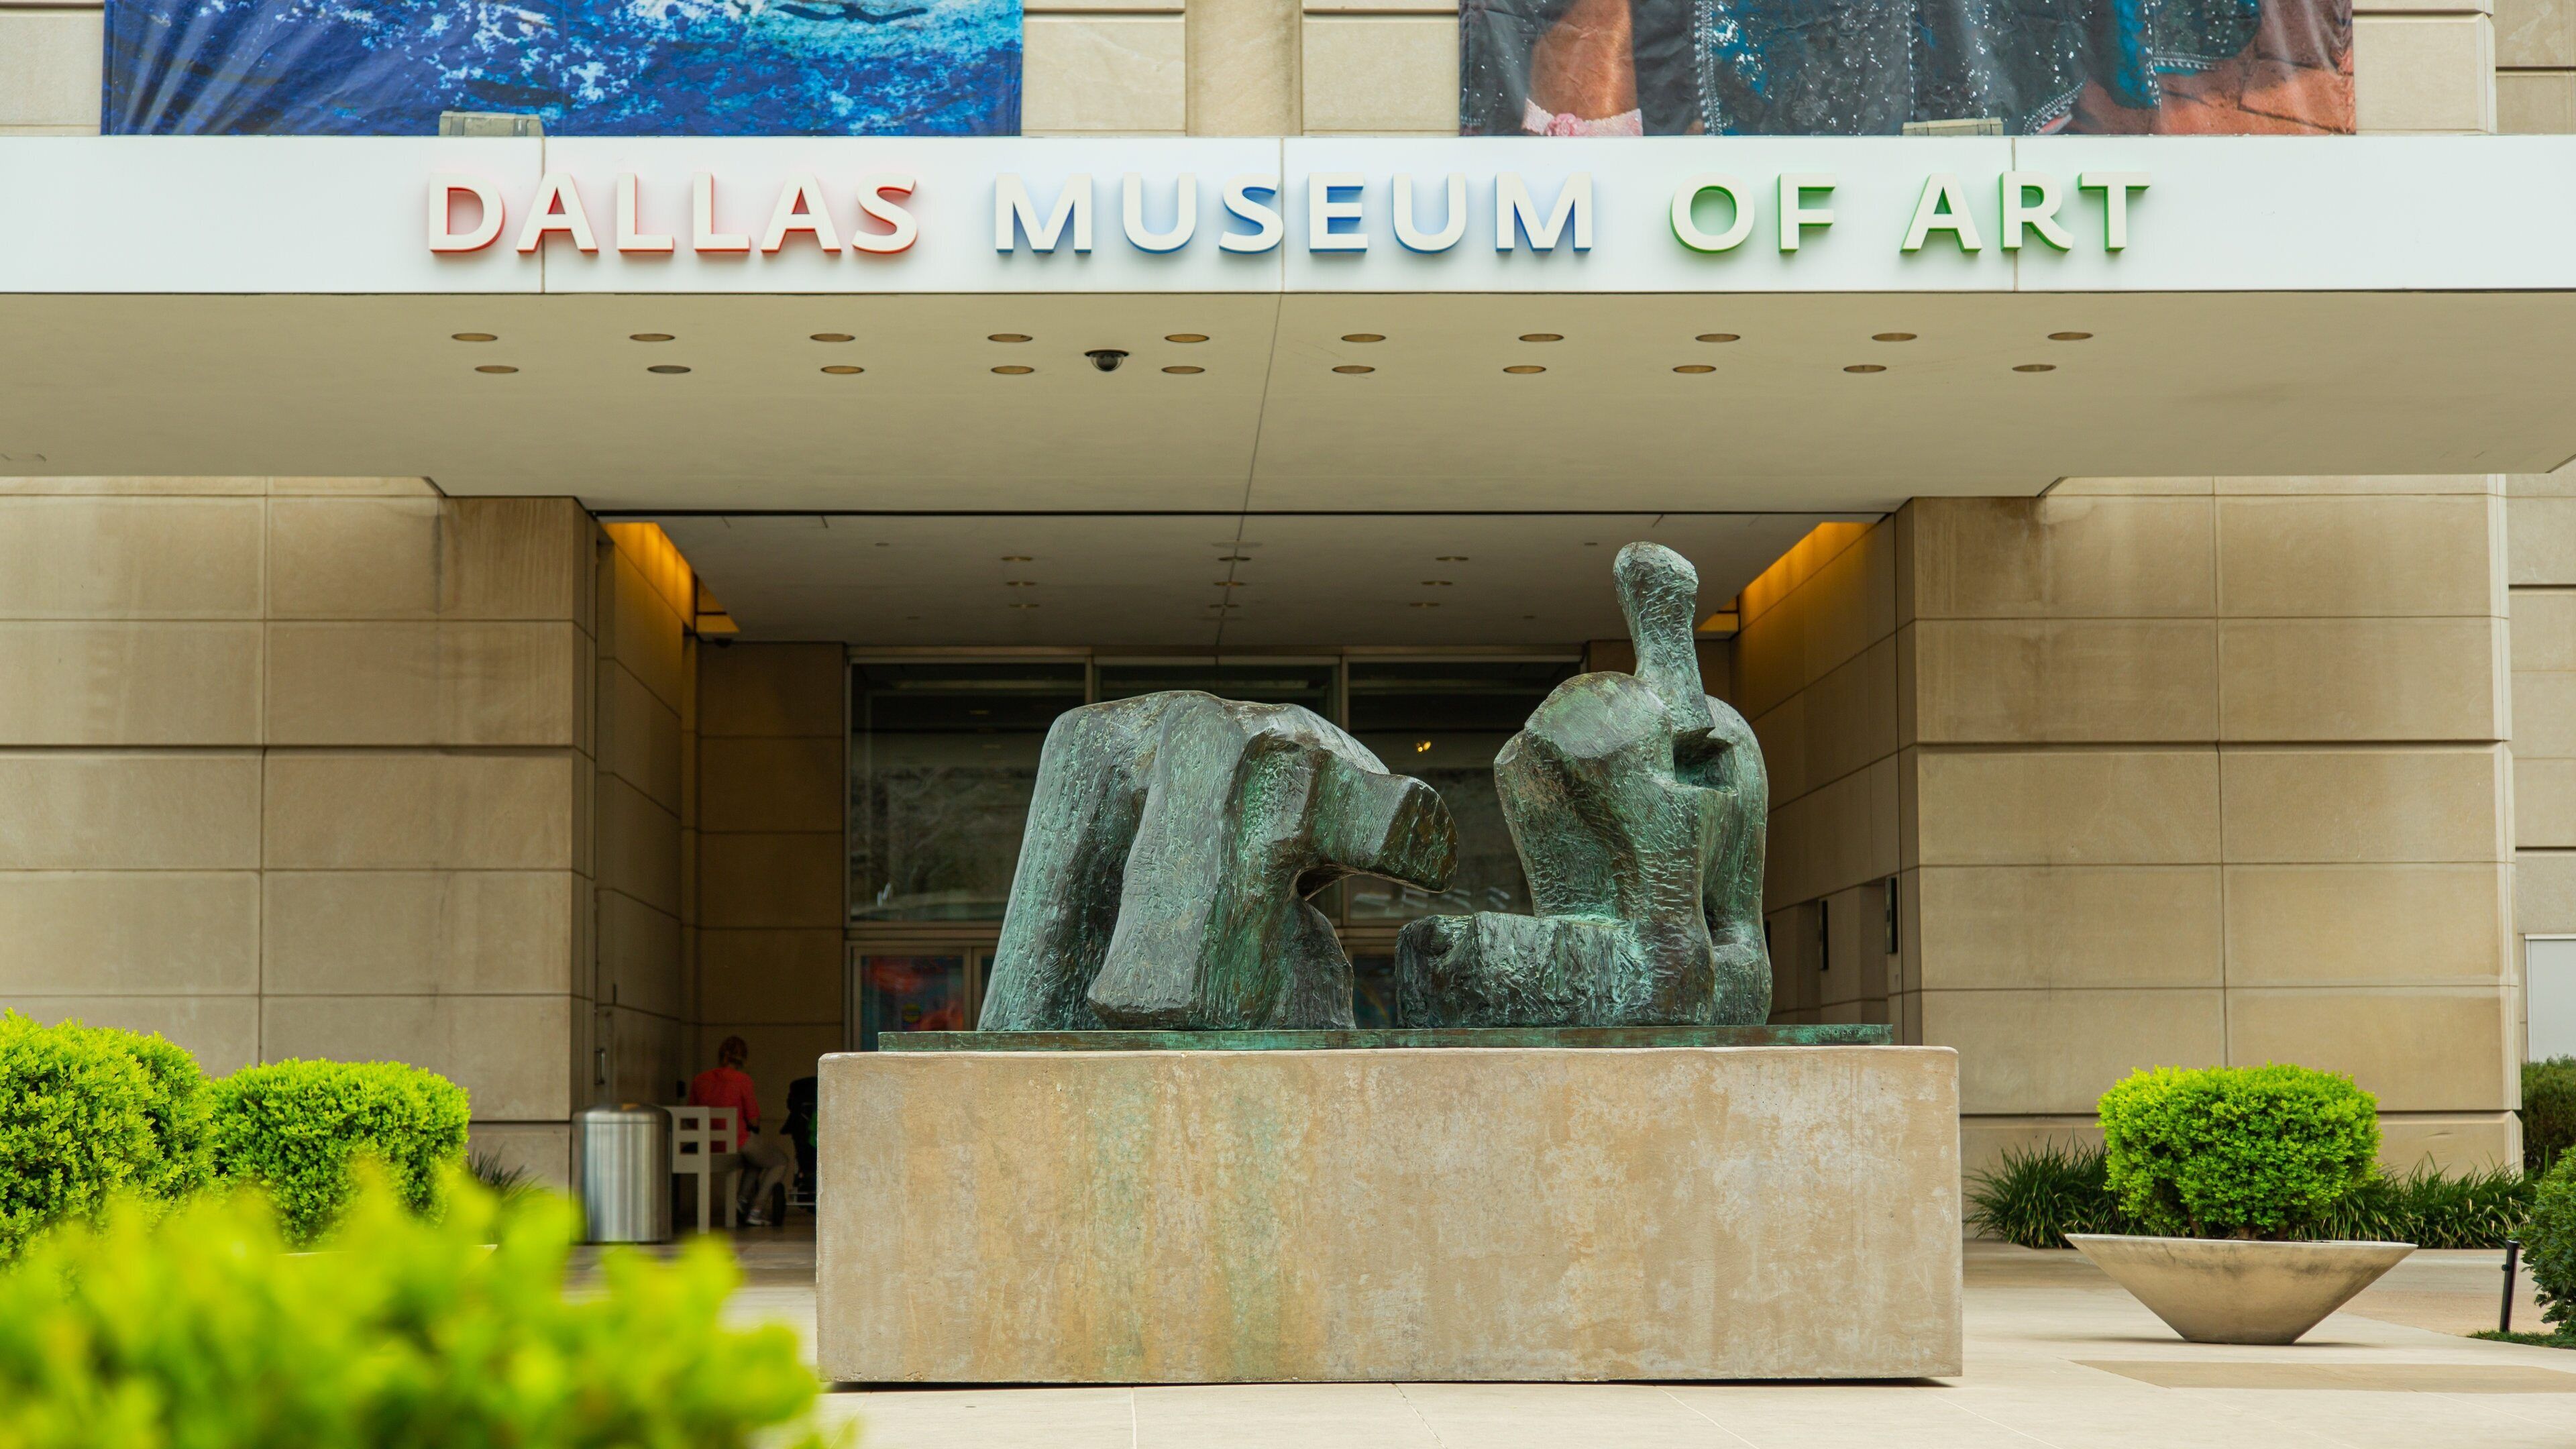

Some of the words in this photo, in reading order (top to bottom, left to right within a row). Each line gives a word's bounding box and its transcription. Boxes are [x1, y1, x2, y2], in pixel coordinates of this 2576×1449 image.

[428, 172, 918, 254] DALLAS
[995, 172, 1593, 255] MUSEUM
[1670, 172, 1837, 254] OF
[1899, 171, 2151, 252] ART
